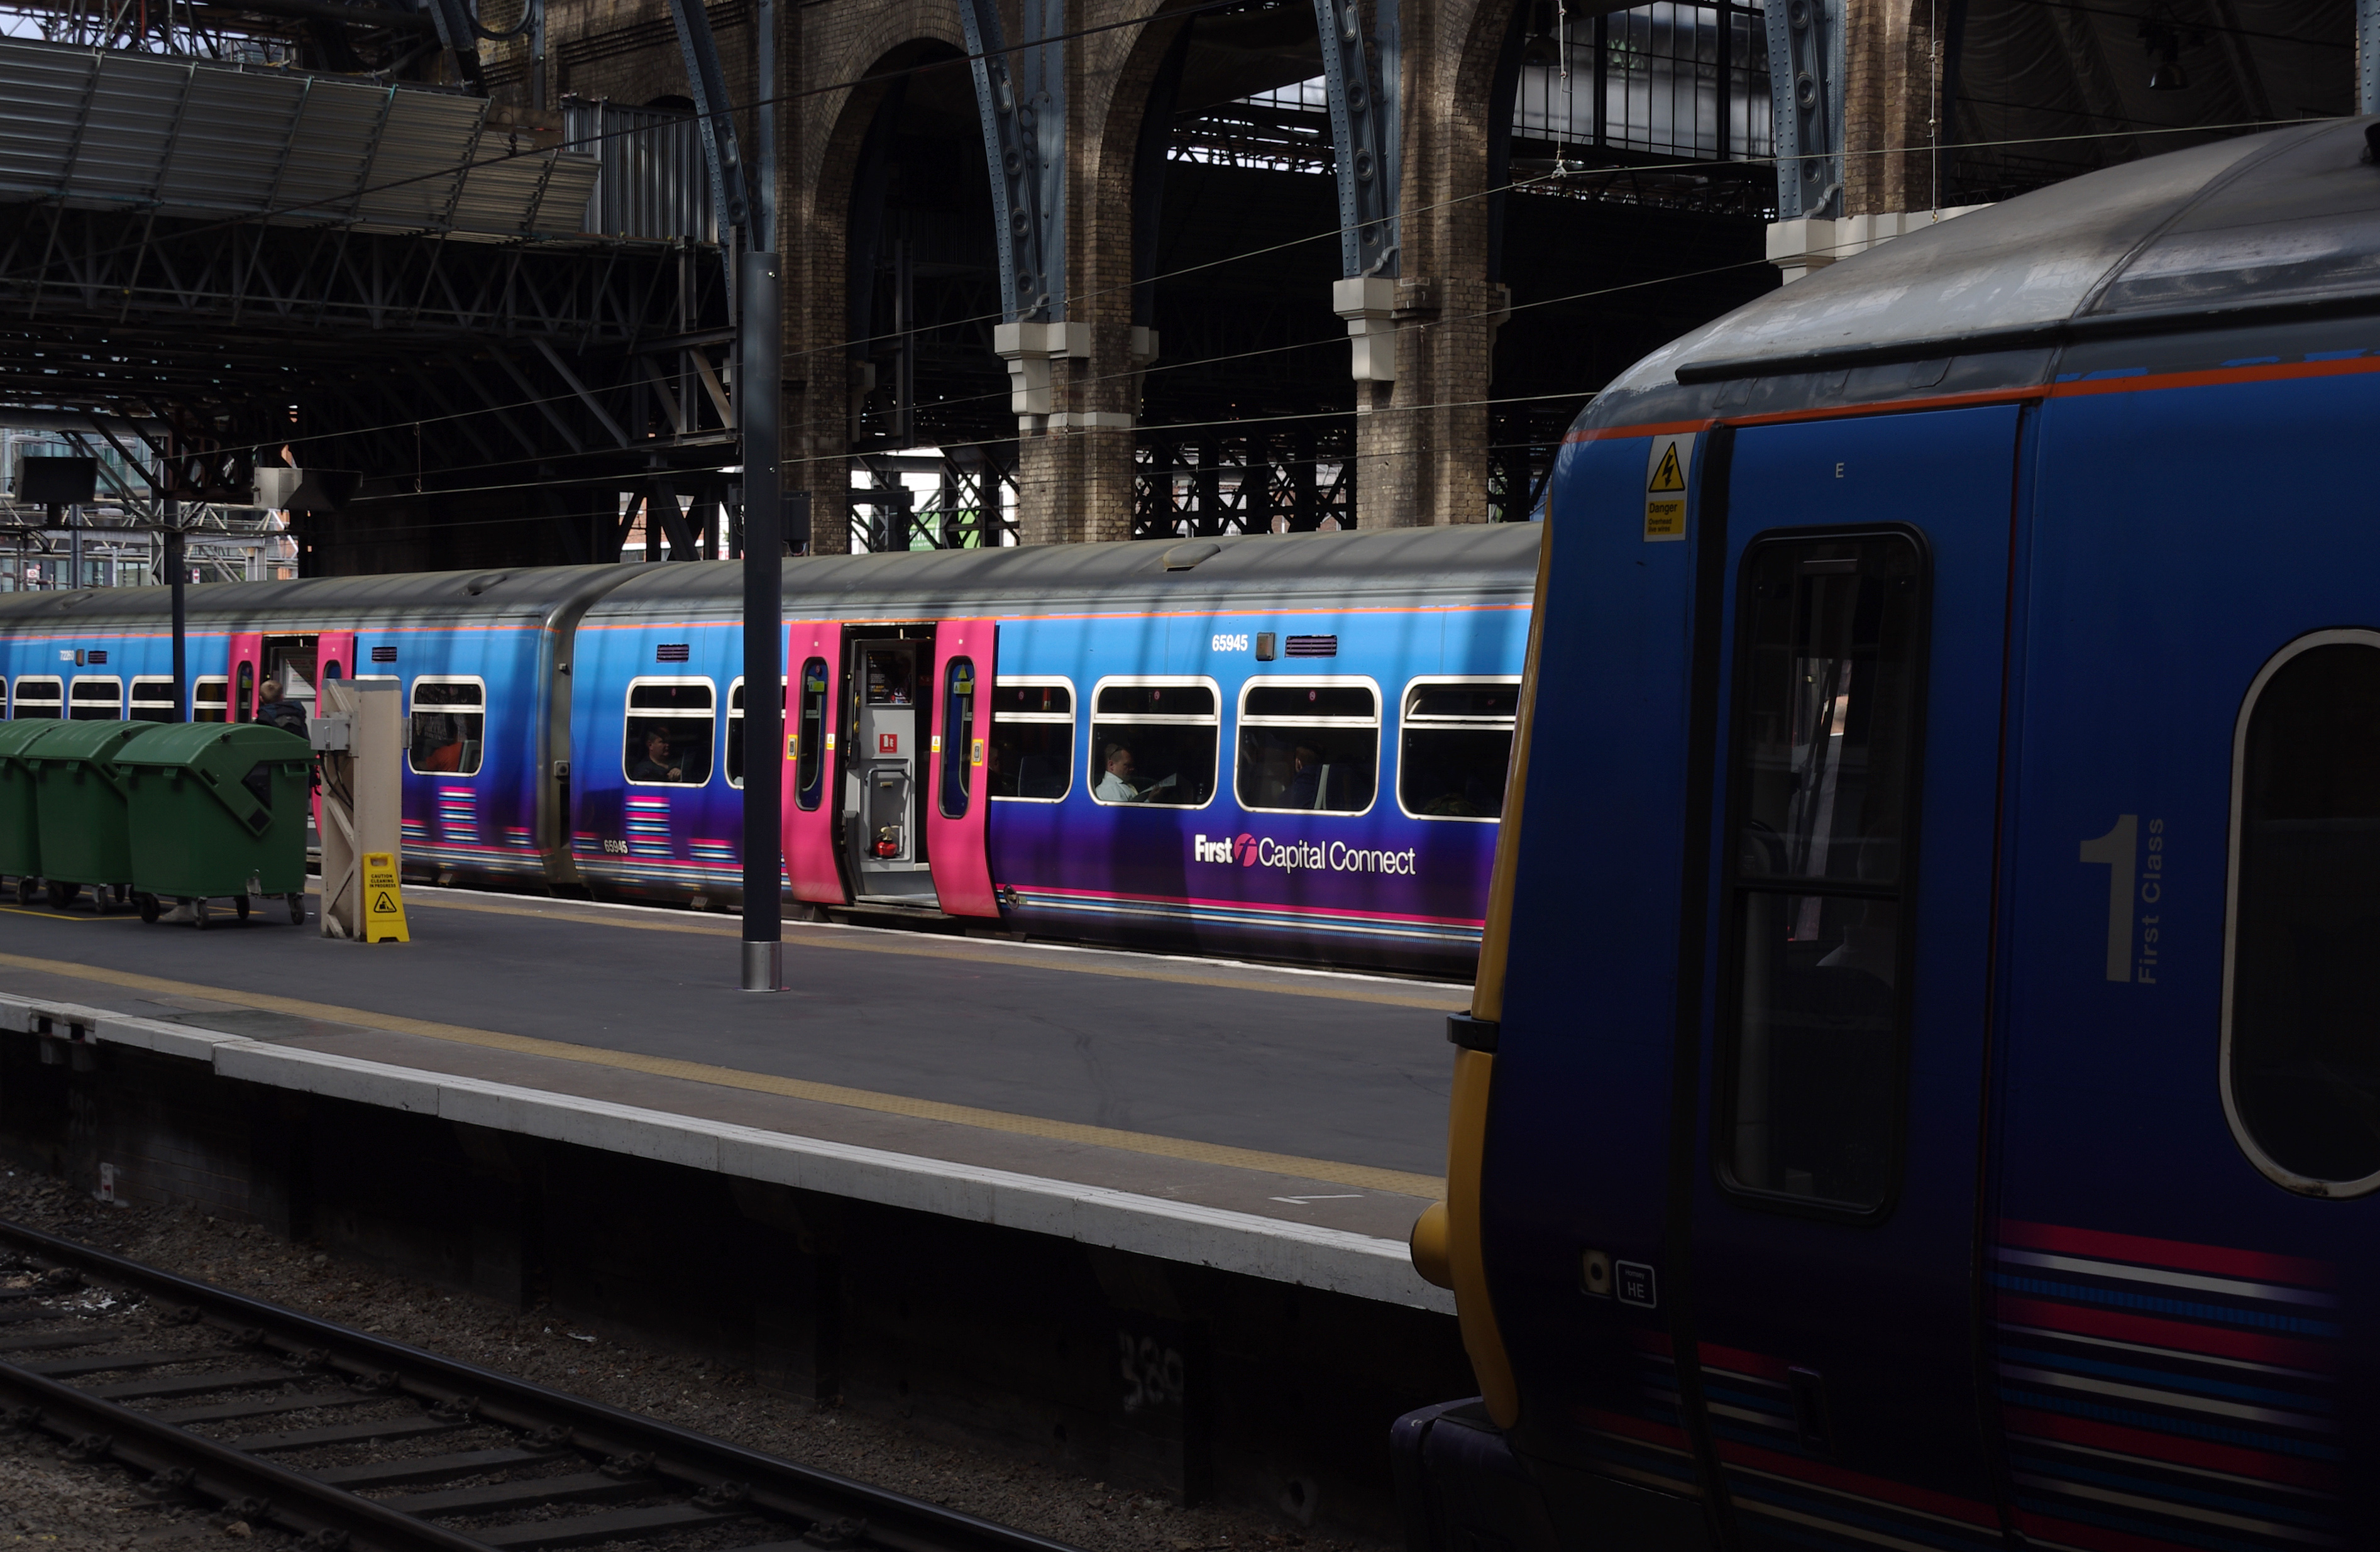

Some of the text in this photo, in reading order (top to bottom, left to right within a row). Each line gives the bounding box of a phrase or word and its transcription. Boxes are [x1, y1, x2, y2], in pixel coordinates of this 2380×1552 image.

[1835, 462, 1845, 478] E
[1649, 502, 1678, 515] Danger
[1212, 634, 1248, 652] 65945
[603, 839, 629, 854] 65945
[1194, 834, 1416, 876] First Capital Connect
[2079, 813, 2138, 982] 1
[2137, 818, 2164, 984] First Class
[1627, 1281, 1645, 1299] HE
